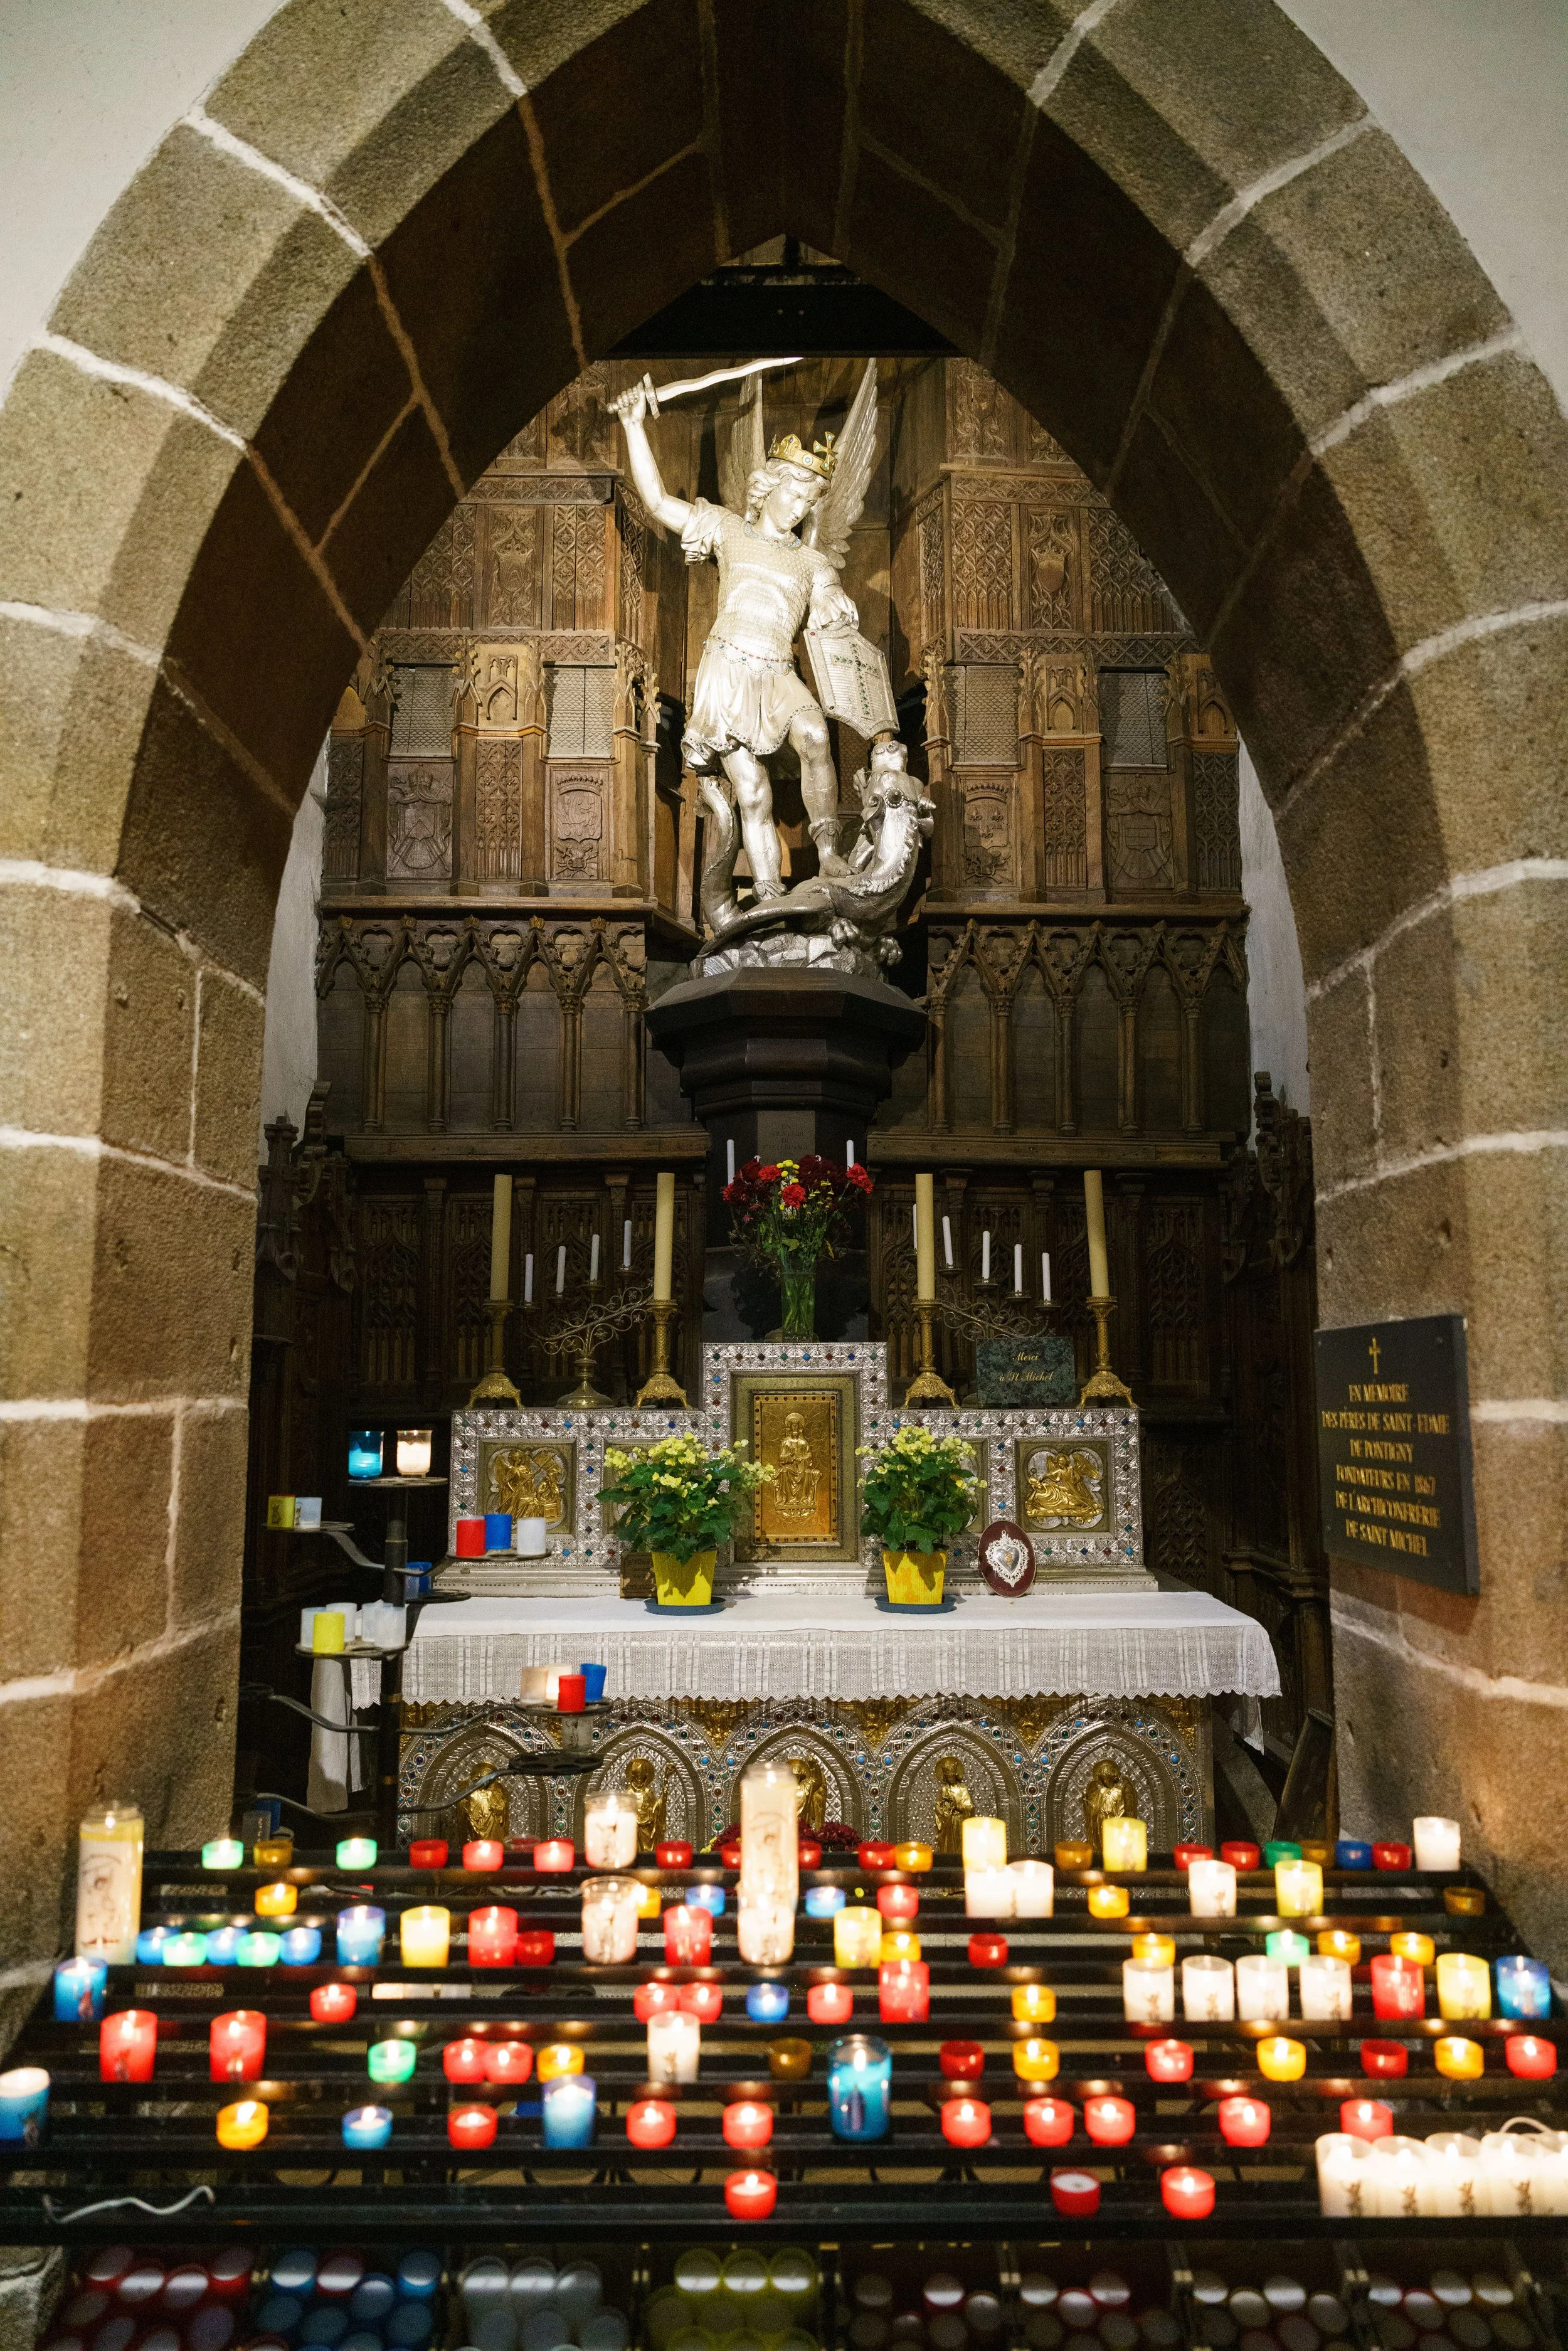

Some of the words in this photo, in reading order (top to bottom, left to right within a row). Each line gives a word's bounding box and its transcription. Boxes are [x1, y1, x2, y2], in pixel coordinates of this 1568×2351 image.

[1012, 1351, 1039, 1361] Merci
[999, 1374, 1005, 1382] à
[1007, 1372, 1019, 1382] St
[1021, 1371, 1054, 1382] Michel
[1349, 1384, 1362, 1402] EN
[1364, 1379, 1409, 1403] MÉMOIRE
[1322, 1411, 1338, 1428] DES
[1367, 1412, 1380, 1431] DE
[1350, 1439, 1363, 1457] DE
[1364, 1440, 1414, 1463] PONTIGNY
[1336, 1464, 1395, 1489] FONDATEURS
[1396, 1472, 1411, 1492] EN
[1335, 1490, 1348, 1509] DE
[1345, 1519, 1359, 1538] DE
[1360, 1522, 1388, 1546] SAINT
[1389, 1529, 1428, 1556] MICHEL
